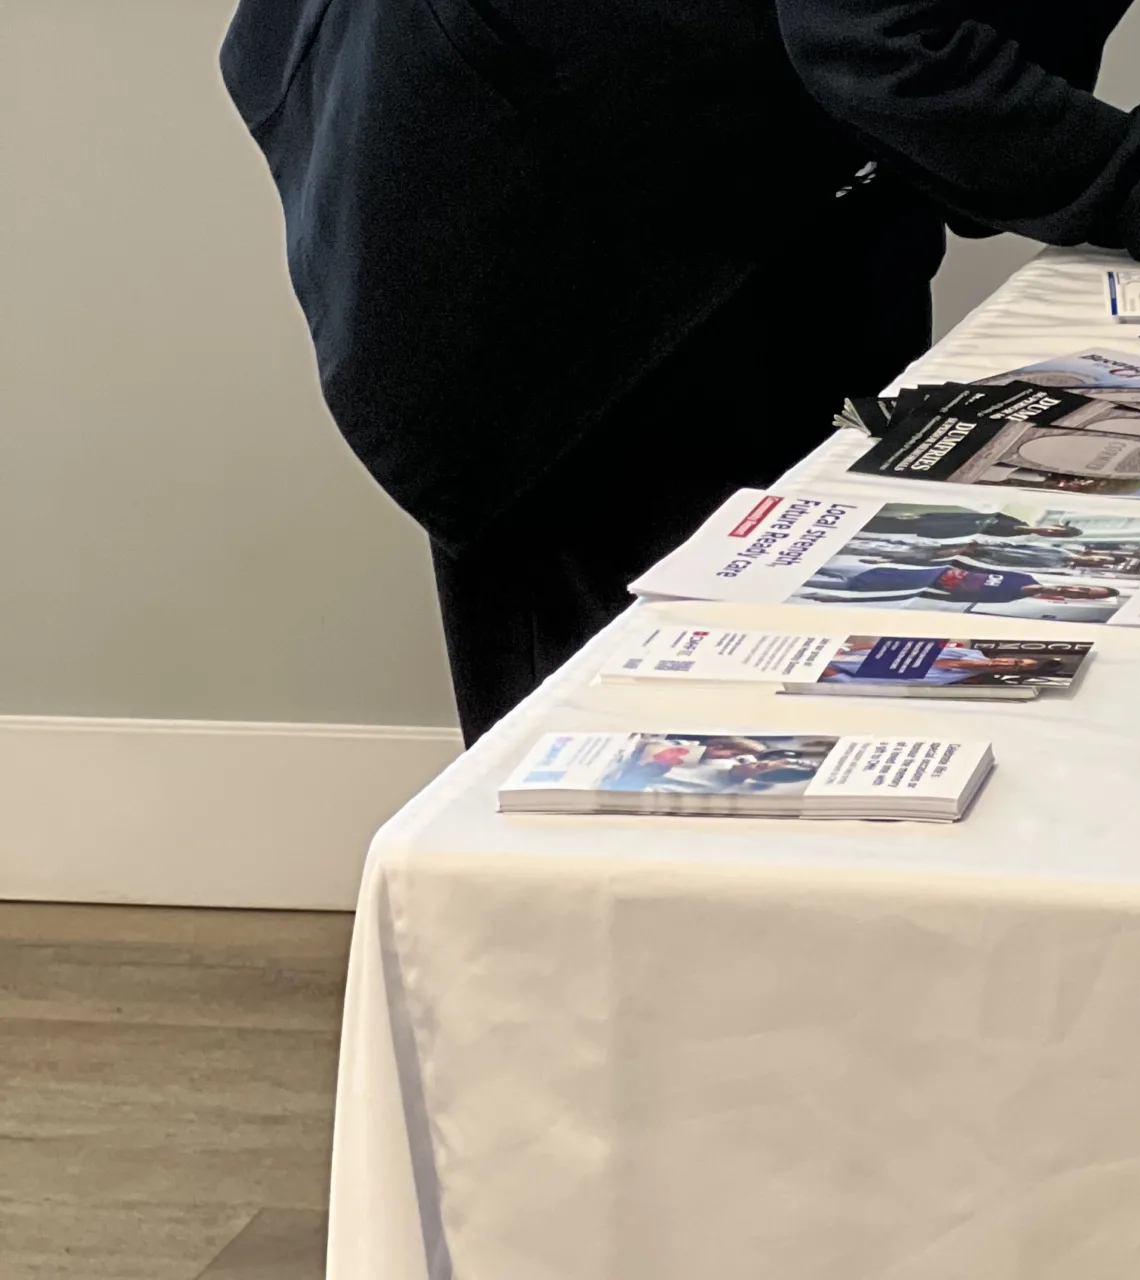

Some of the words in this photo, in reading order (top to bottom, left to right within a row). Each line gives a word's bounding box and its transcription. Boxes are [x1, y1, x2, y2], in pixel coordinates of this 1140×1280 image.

[911, 421, 977, 471] DUMFRIES
[770, 498, 822, 530] Future
[812, 503, 858, 529] Local
[736, 531, 790, 559] Ready
[767, 528, 827, 567] strength,
[716, 559, 753, 578] care
[906, 741, 925, 759] honour
[924, 742, 941, 759] special
[938, 743, 961, 765] Celebrate
[900, 758, 915, 768] the
[910, 758, 931, 782] occasions
[930, 765, 948, 778] life's
[887, 767, 909, 788] memory
